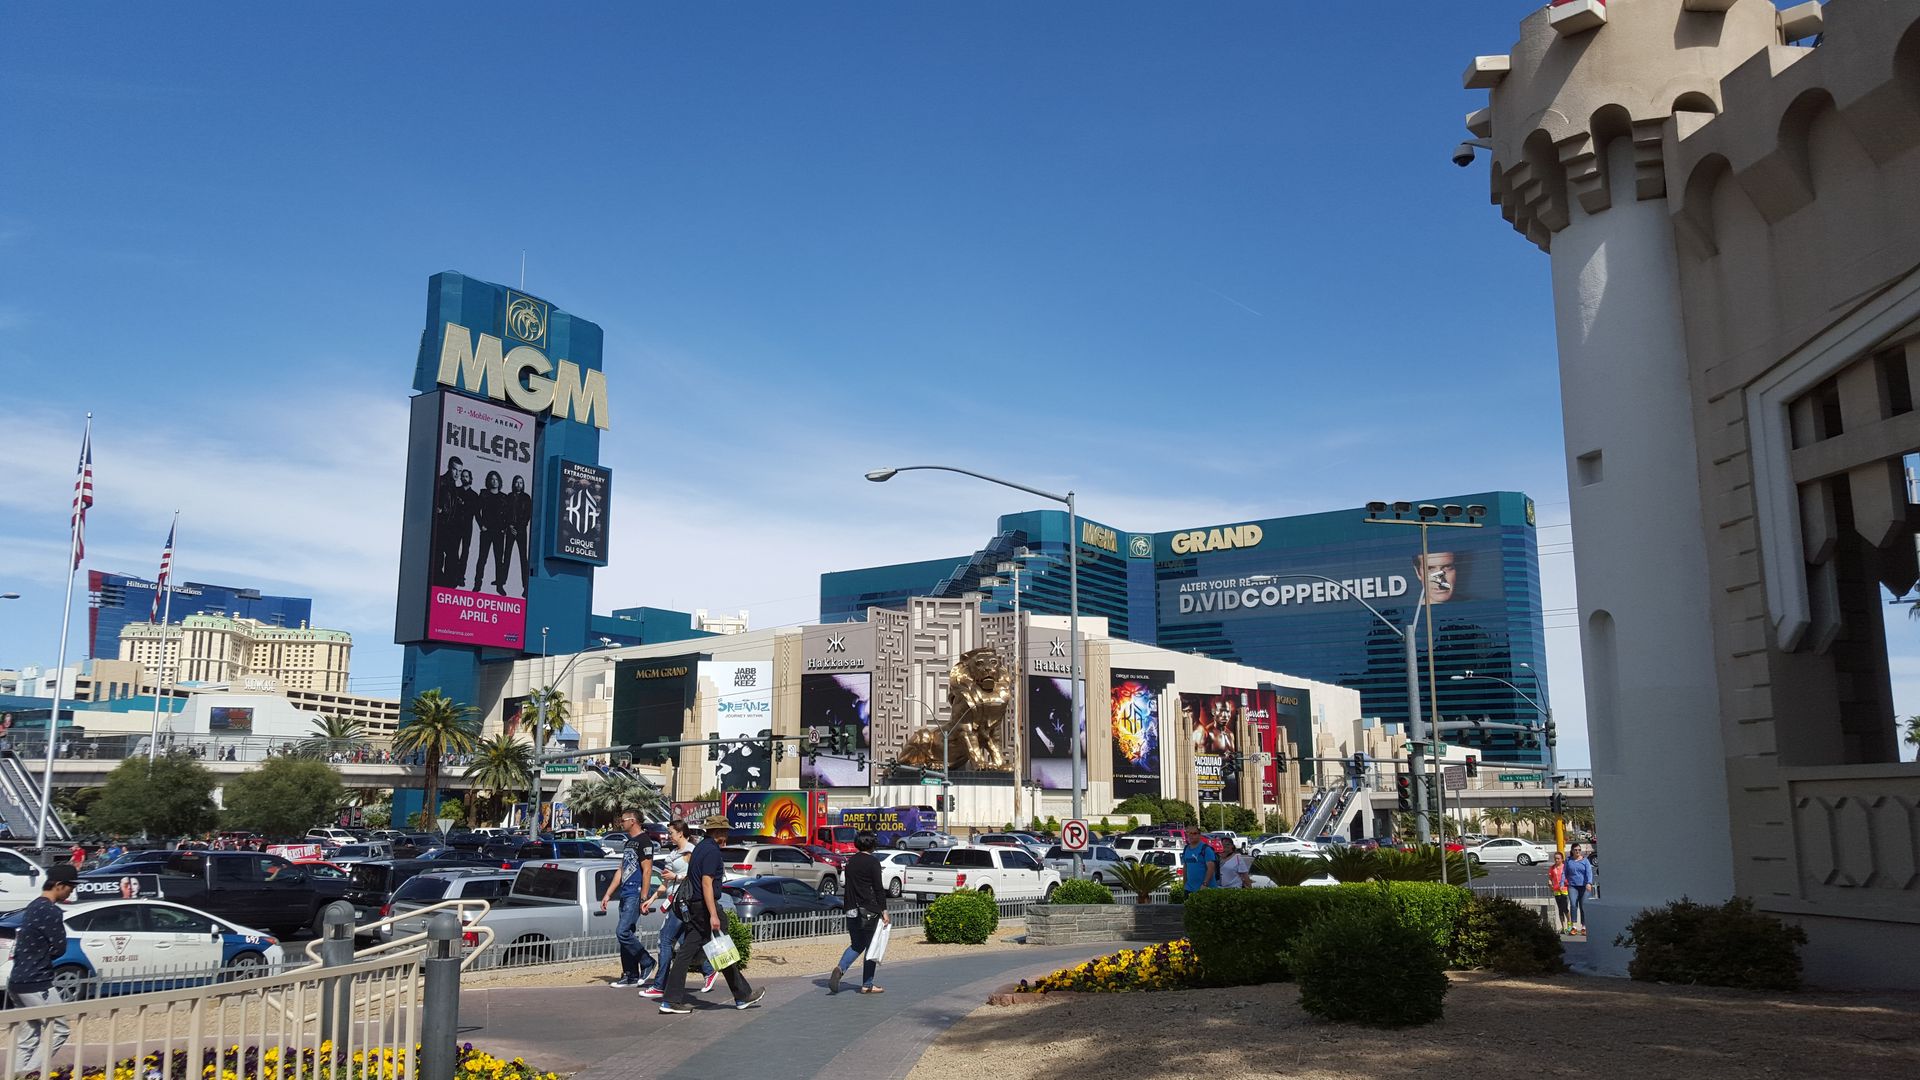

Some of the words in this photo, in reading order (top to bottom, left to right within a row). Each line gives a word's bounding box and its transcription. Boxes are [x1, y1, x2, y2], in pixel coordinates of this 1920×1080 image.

[437, 322, 609, 431] MGM
[495, 418, 519, 429] ARENA
[563, 468, 606, 483] EXTRAORDINARY
[574, 464, 596, 475] EPICALLY
[569, 537, 594, 549] CIRQUE
[1082, 521, 1117, 553] MGM
[1171, 524, 1263, 555] GRAND
[564, 545, 575, 554] DU
[575, 547, 598, 558] SOLEIL
[126, 580, 149, 589] Hilton
[171, 585, 203, 596] Vacations
[1179, 579, 1207, 593] ALTER
[1209, 576, 1237, 590] YOUR
[436, 592, 474, 607] GRAND
[476, 598, 521, 614] OPENING
[459, 609, 489, 623] APRIL
[491, 613, 498, 624] 6
[807, 656, 865, 670] Hakkasan
[636, 669, 660, 679] MGM
[660, 666, 688, 677] GRAND
[734, 667, 757, 675] JABB
[1195, 766, 1221, 776] BRADLEY
[843, 813, 865, 822] DARE
[867, 813, 878, 822] TO
[879, 813, 898, 822] LIVE
[853, 822, 872, 831] FULL
[875, 822, 907, 831] COLOR.
[77, 881, 120, 893] BODIES
[245, 935, 261, 945] 692
